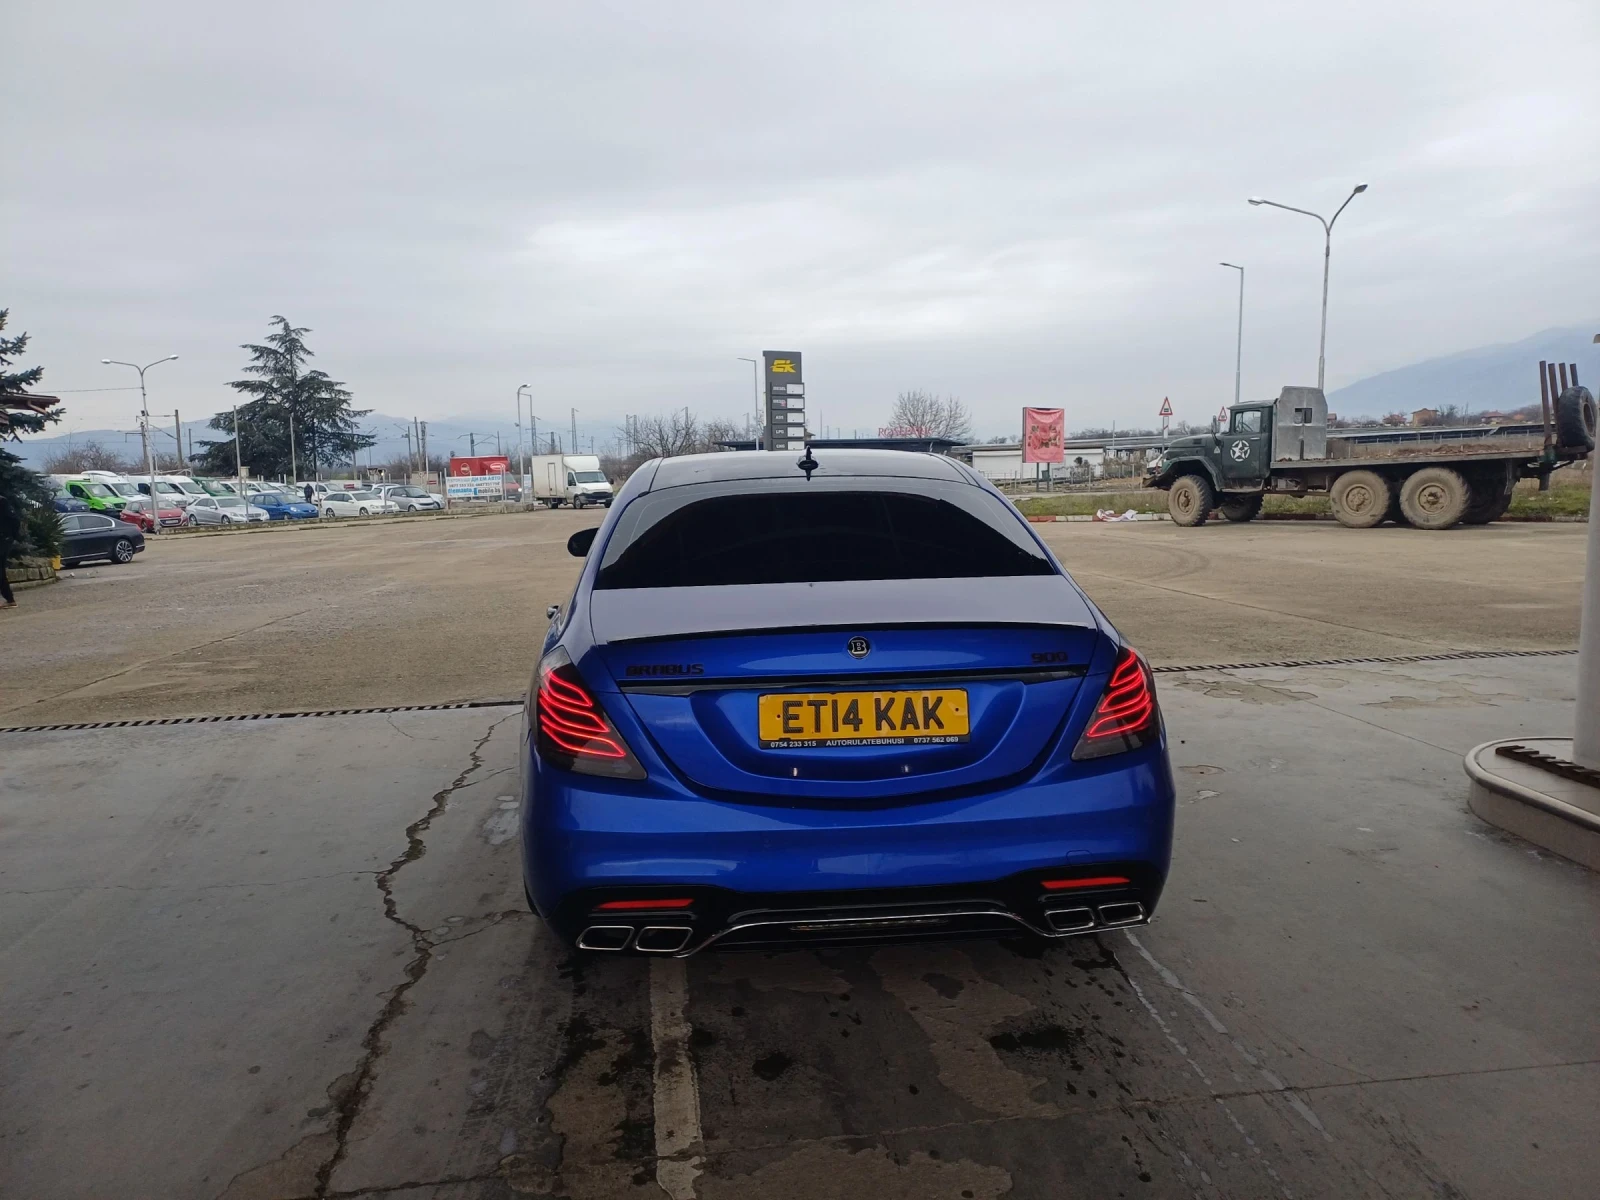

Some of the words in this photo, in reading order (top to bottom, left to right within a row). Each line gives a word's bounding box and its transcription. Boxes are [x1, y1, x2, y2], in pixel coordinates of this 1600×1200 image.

[851, 639, 867, 654] B
[1032, 652, 1068, 663] 900
[626, 664, 704, 676] BRABUS
[782, 698, 863, 734] ET14
[874, 696, 945, 731] KAK
[826, 738, 905, 747] AUTORULATEBUHUSI
[932, 736, 945, 744] 562
